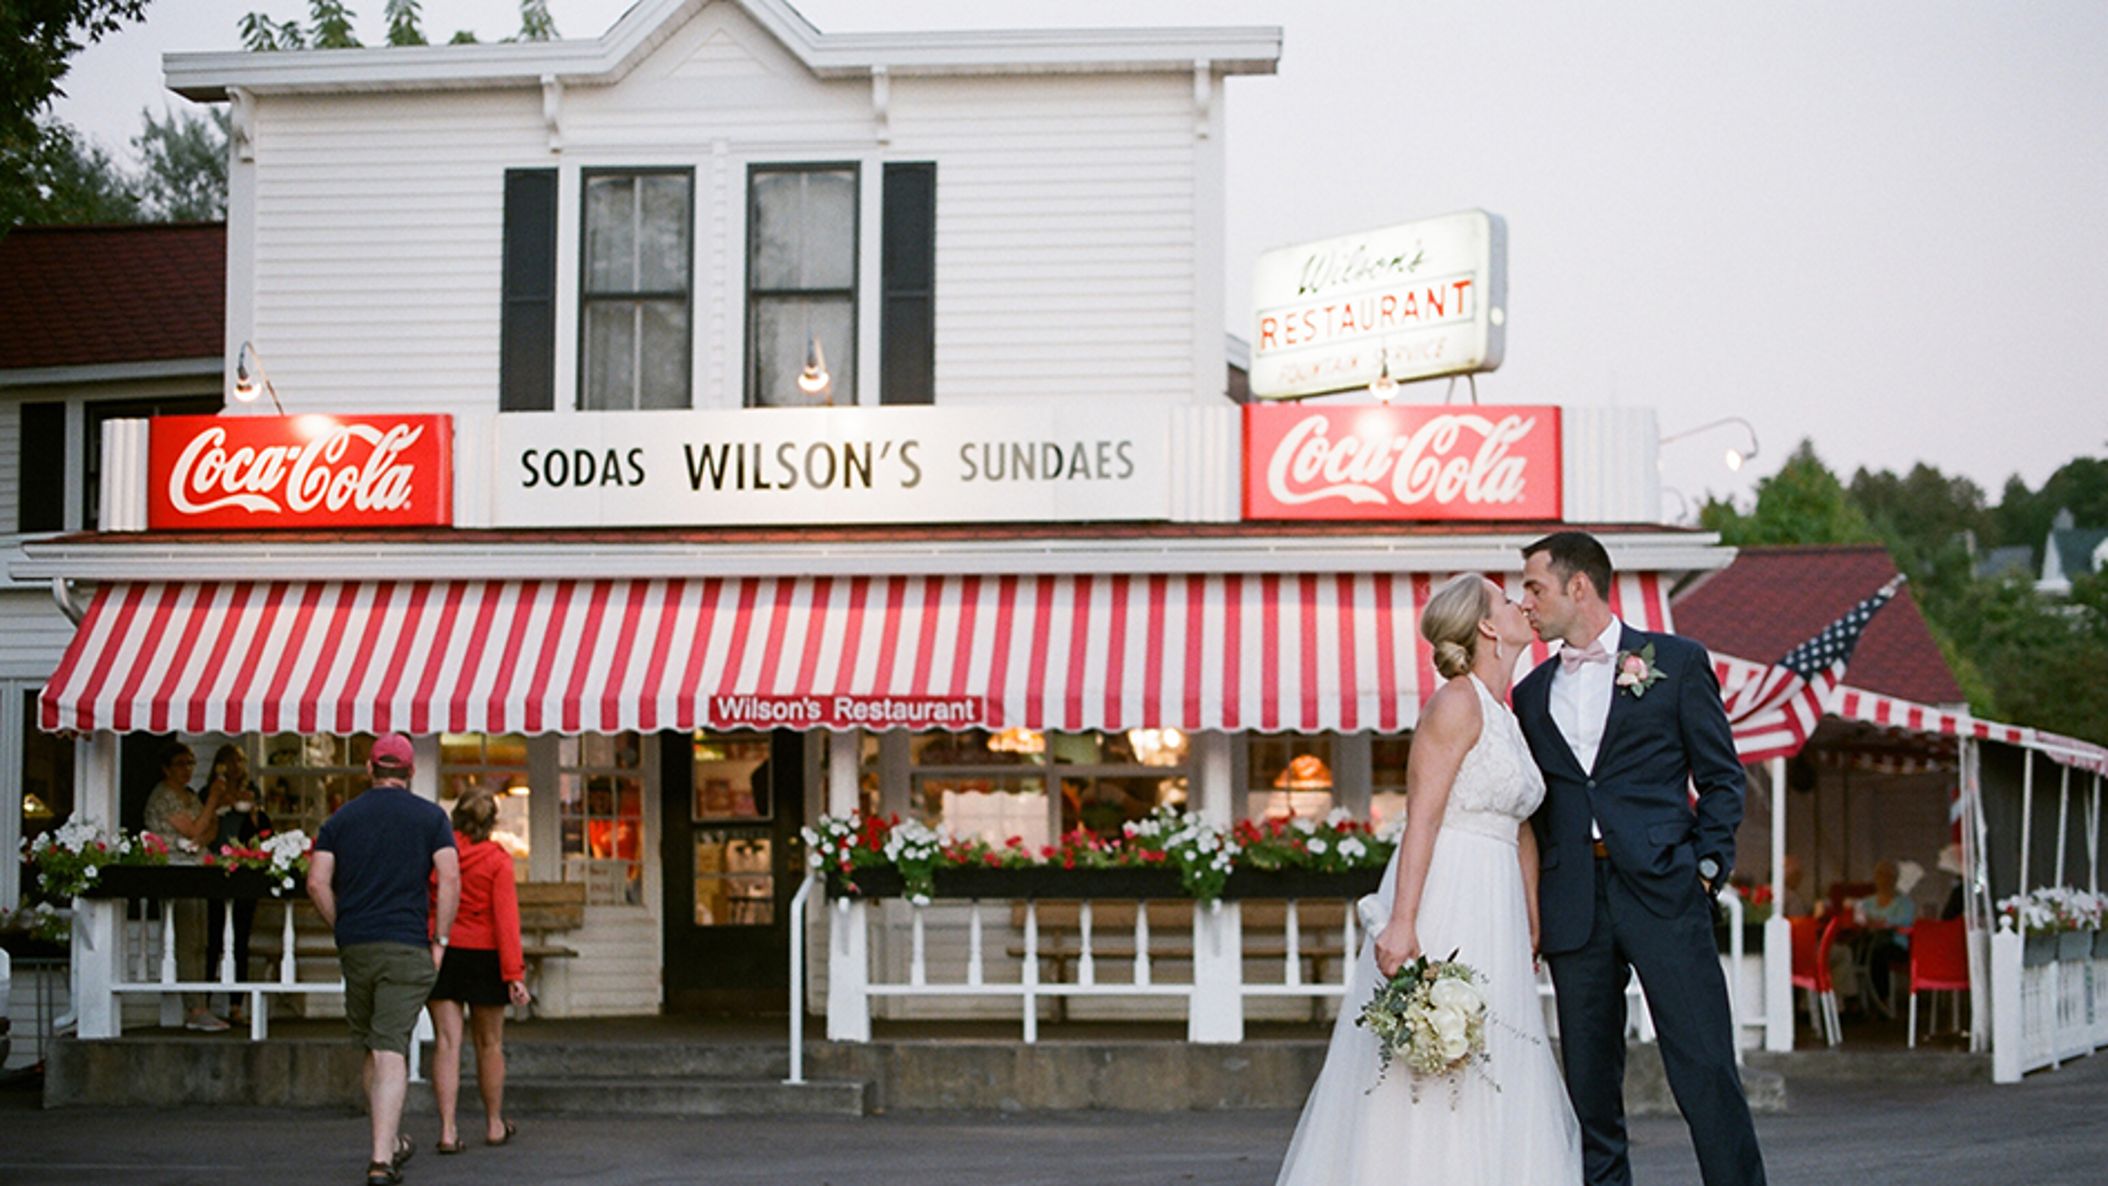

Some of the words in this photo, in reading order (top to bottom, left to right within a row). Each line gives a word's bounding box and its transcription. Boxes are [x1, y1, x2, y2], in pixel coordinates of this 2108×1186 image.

[1259, 279, 1473, 350] RESTAURANT
[169, 422, 424, 514] Coca-Cola
[521, 447, 646, 487] SODAS
[684, 439, 922, 490] WILSON'S
[960, 439, 1135, 481] SUNDAES
[1267, 414, 1535, 505] Coca-Cola
[718, 696, 821, 721] Wilson's
[834, 696, 974, 721] Restaurant
